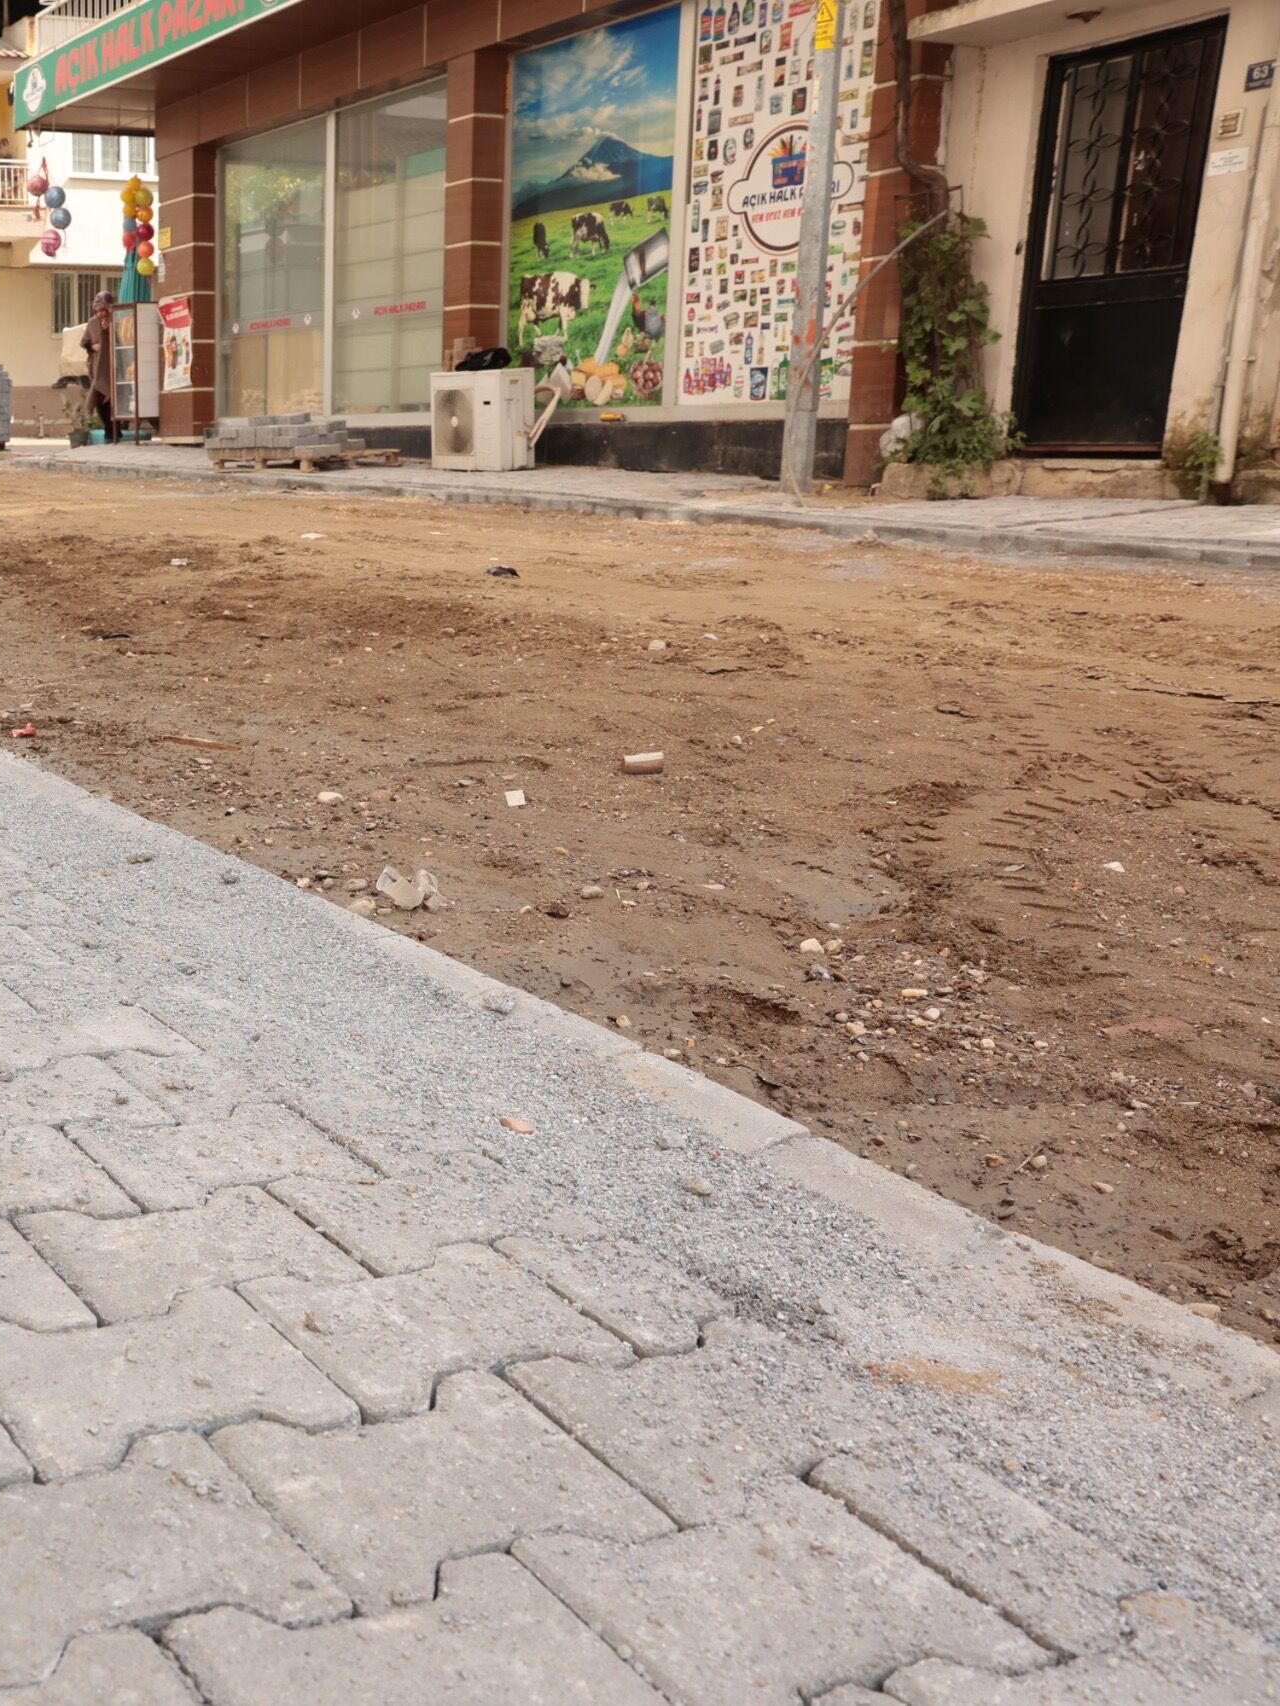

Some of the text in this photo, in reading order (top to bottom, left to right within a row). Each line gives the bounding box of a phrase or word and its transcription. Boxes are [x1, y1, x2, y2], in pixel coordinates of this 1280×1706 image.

[55, 36, 100, 95] AÇIK
[102, 9, 155, 73] HALK
[1252, 64, 1269, 80] 63
[769, 188, 797, 203] HALK
